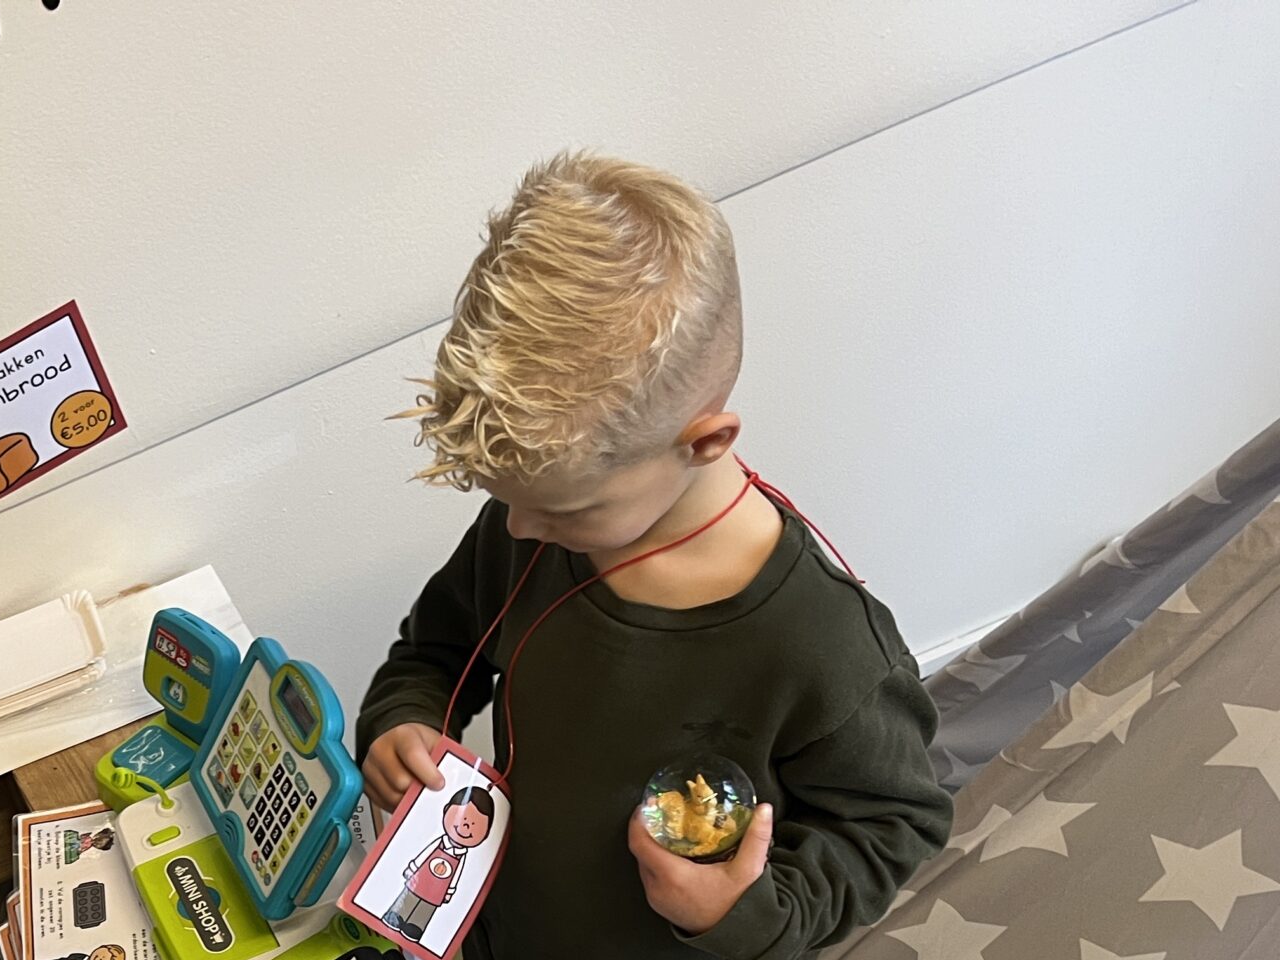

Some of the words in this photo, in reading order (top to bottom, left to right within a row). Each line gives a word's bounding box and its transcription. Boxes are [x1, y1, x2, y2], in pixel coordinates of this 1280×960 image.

[58, 411, 69, 423] 2
[178, 874, 202, 901] MINI
[192, 900, 220, 933] SHOP
